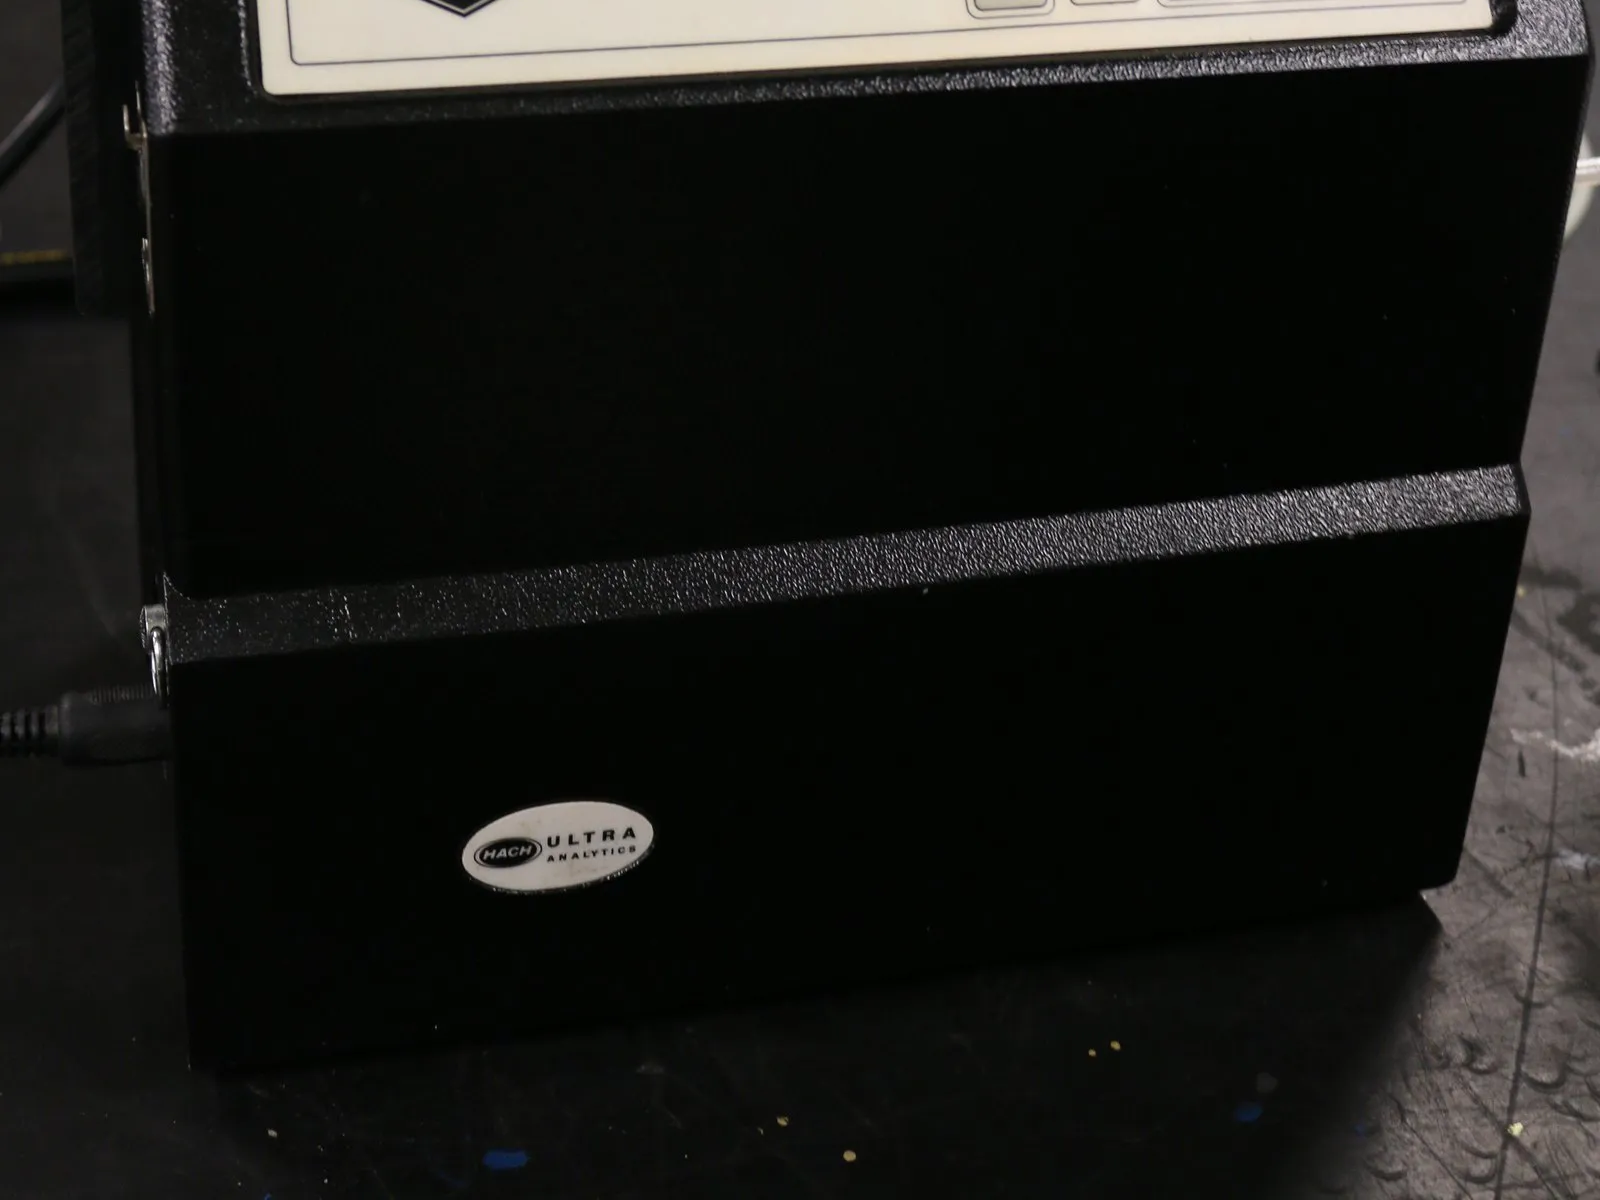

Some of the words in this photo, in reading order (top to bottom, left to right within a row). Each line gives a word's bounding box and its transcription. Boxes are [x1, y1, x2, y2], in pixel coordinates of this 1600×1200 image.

[547, 827, 636, 848] ULTRA
[482, 845, 533, 861] HACH
[547, 845, 636, 862] ANALYTICS
